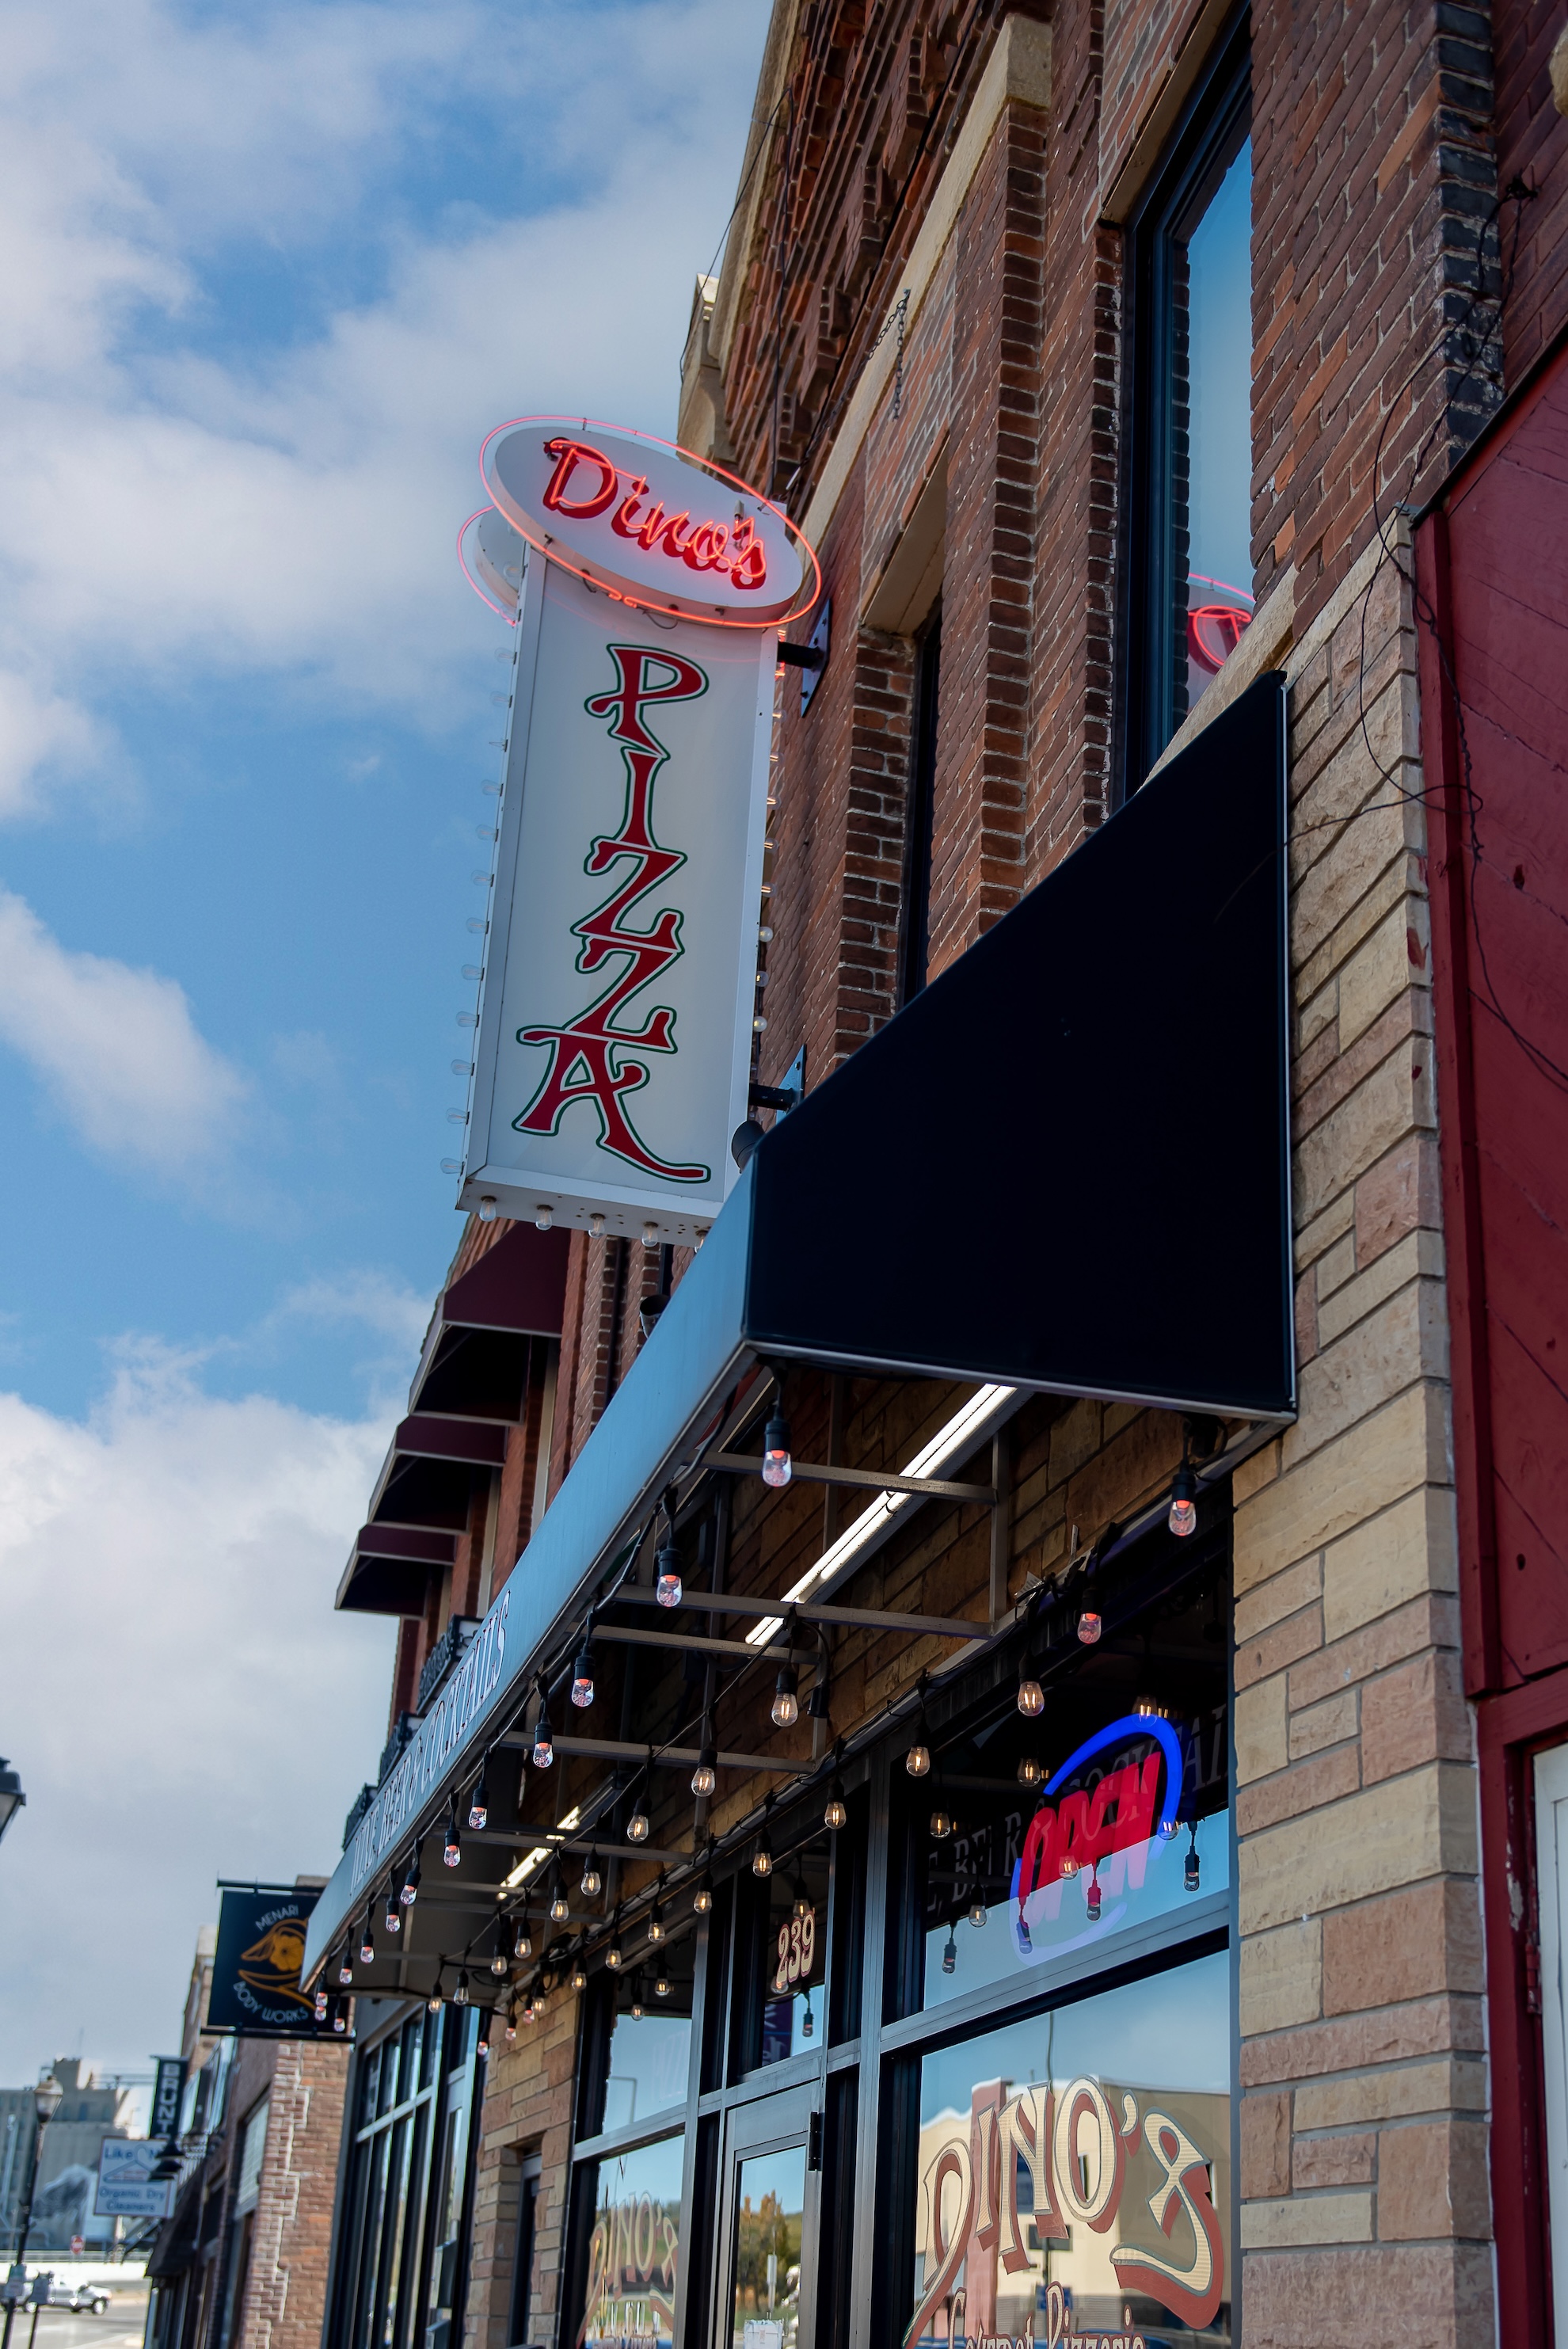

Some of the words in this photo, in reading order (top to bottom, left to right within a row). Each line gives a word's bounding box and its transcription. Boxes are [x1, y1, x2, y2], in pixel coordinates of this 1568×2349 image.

[542, 436, 768, 590] Dino's
[512, 643, 711, 1182] PIZZA
[377, 1754, 412, 1857] BEER
[409, 1736, 423, 1813] &
[420, 1588, 512, 1795] COCKTAILS
[1018, 1751, 1162, 1930] OPEN
[776, 1910, 816, 1990] 239
[233, 1980, 263, 2014] BODY
[261, 2006, 310, 2023] WORKS
[104, 2145, 134, 2161] Like
[98, 2186, 141, 2199] Organic
[146, 2187, 166, 2202] Dry
[106, 2200, 156, 2212] Cleaners
